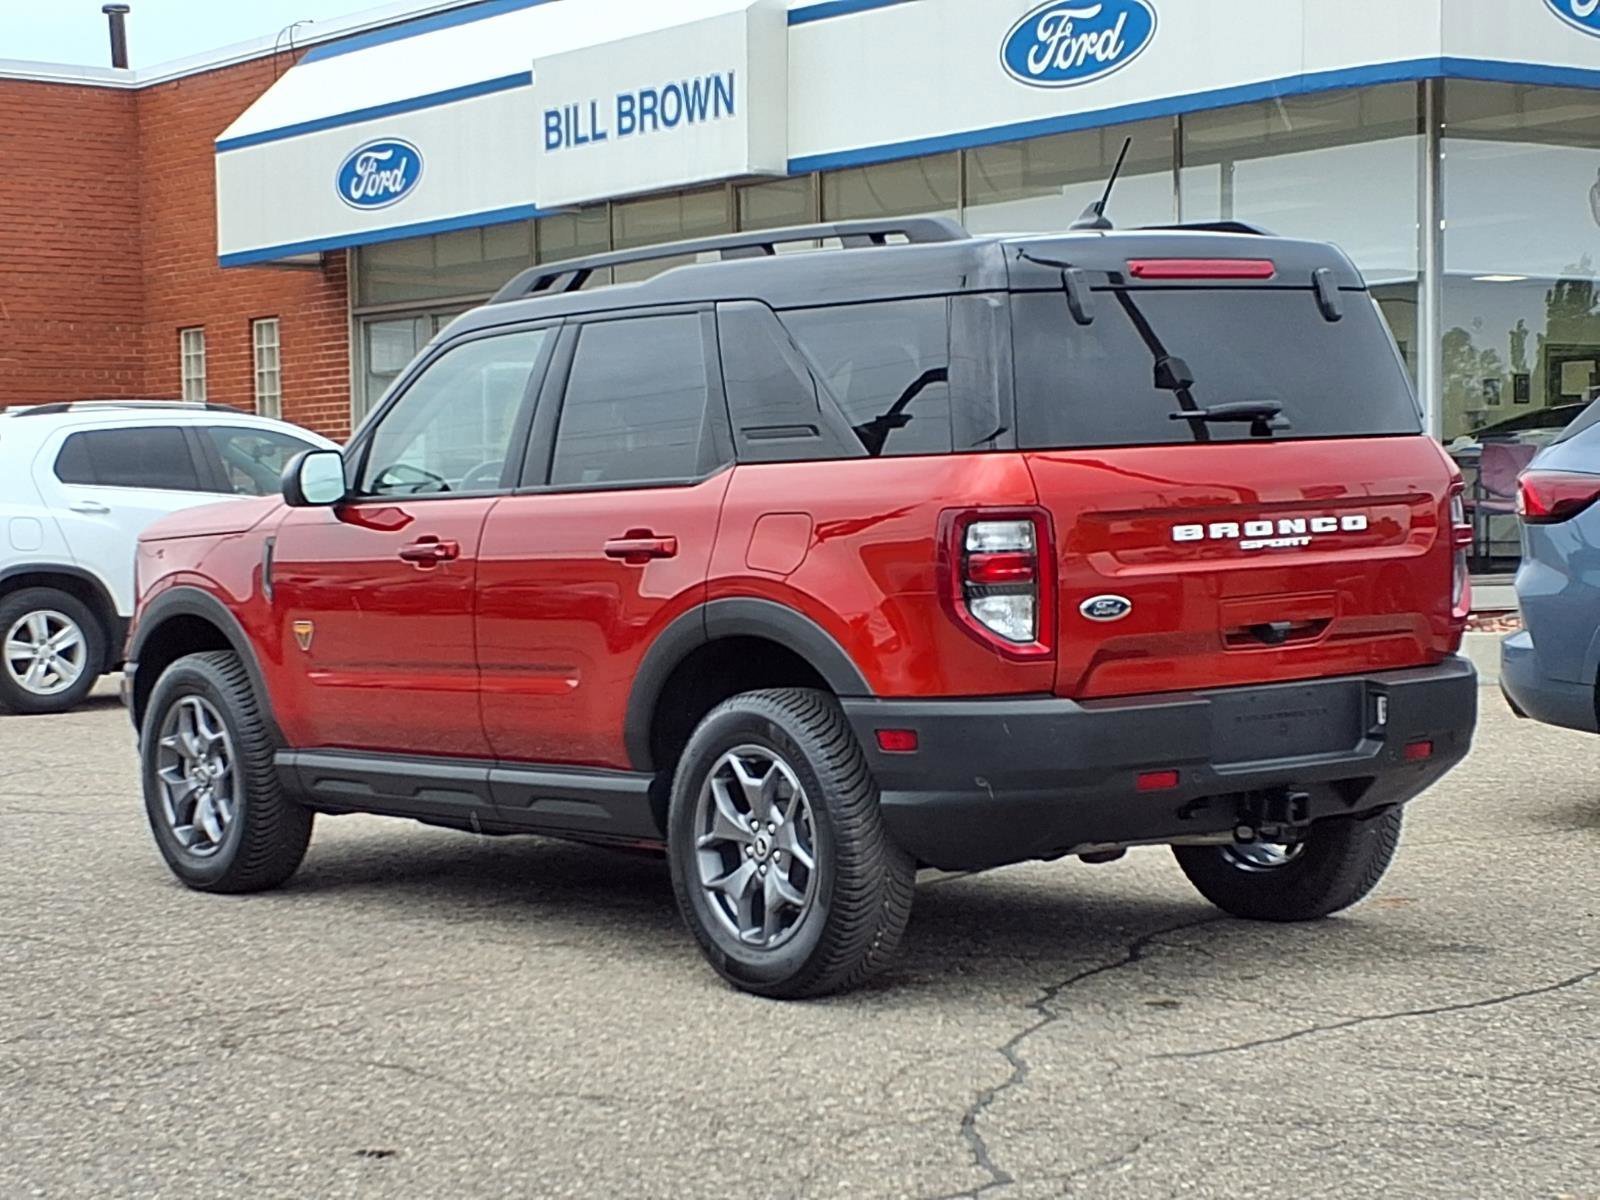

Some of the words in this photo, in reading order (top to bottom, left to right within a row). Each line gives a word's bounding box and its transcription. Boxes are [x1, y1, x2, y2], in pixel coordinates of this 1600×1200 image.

[1027, 3, 1128, 75] Ford
[544, 101, 608, 152] BILL
[617, 71, 736, 137] BROWN
[350, 149, 408, 199] Ford
[1172, 515, 1368, 541] BRONCO
[1240, 536, 1313, 550] SPORT
